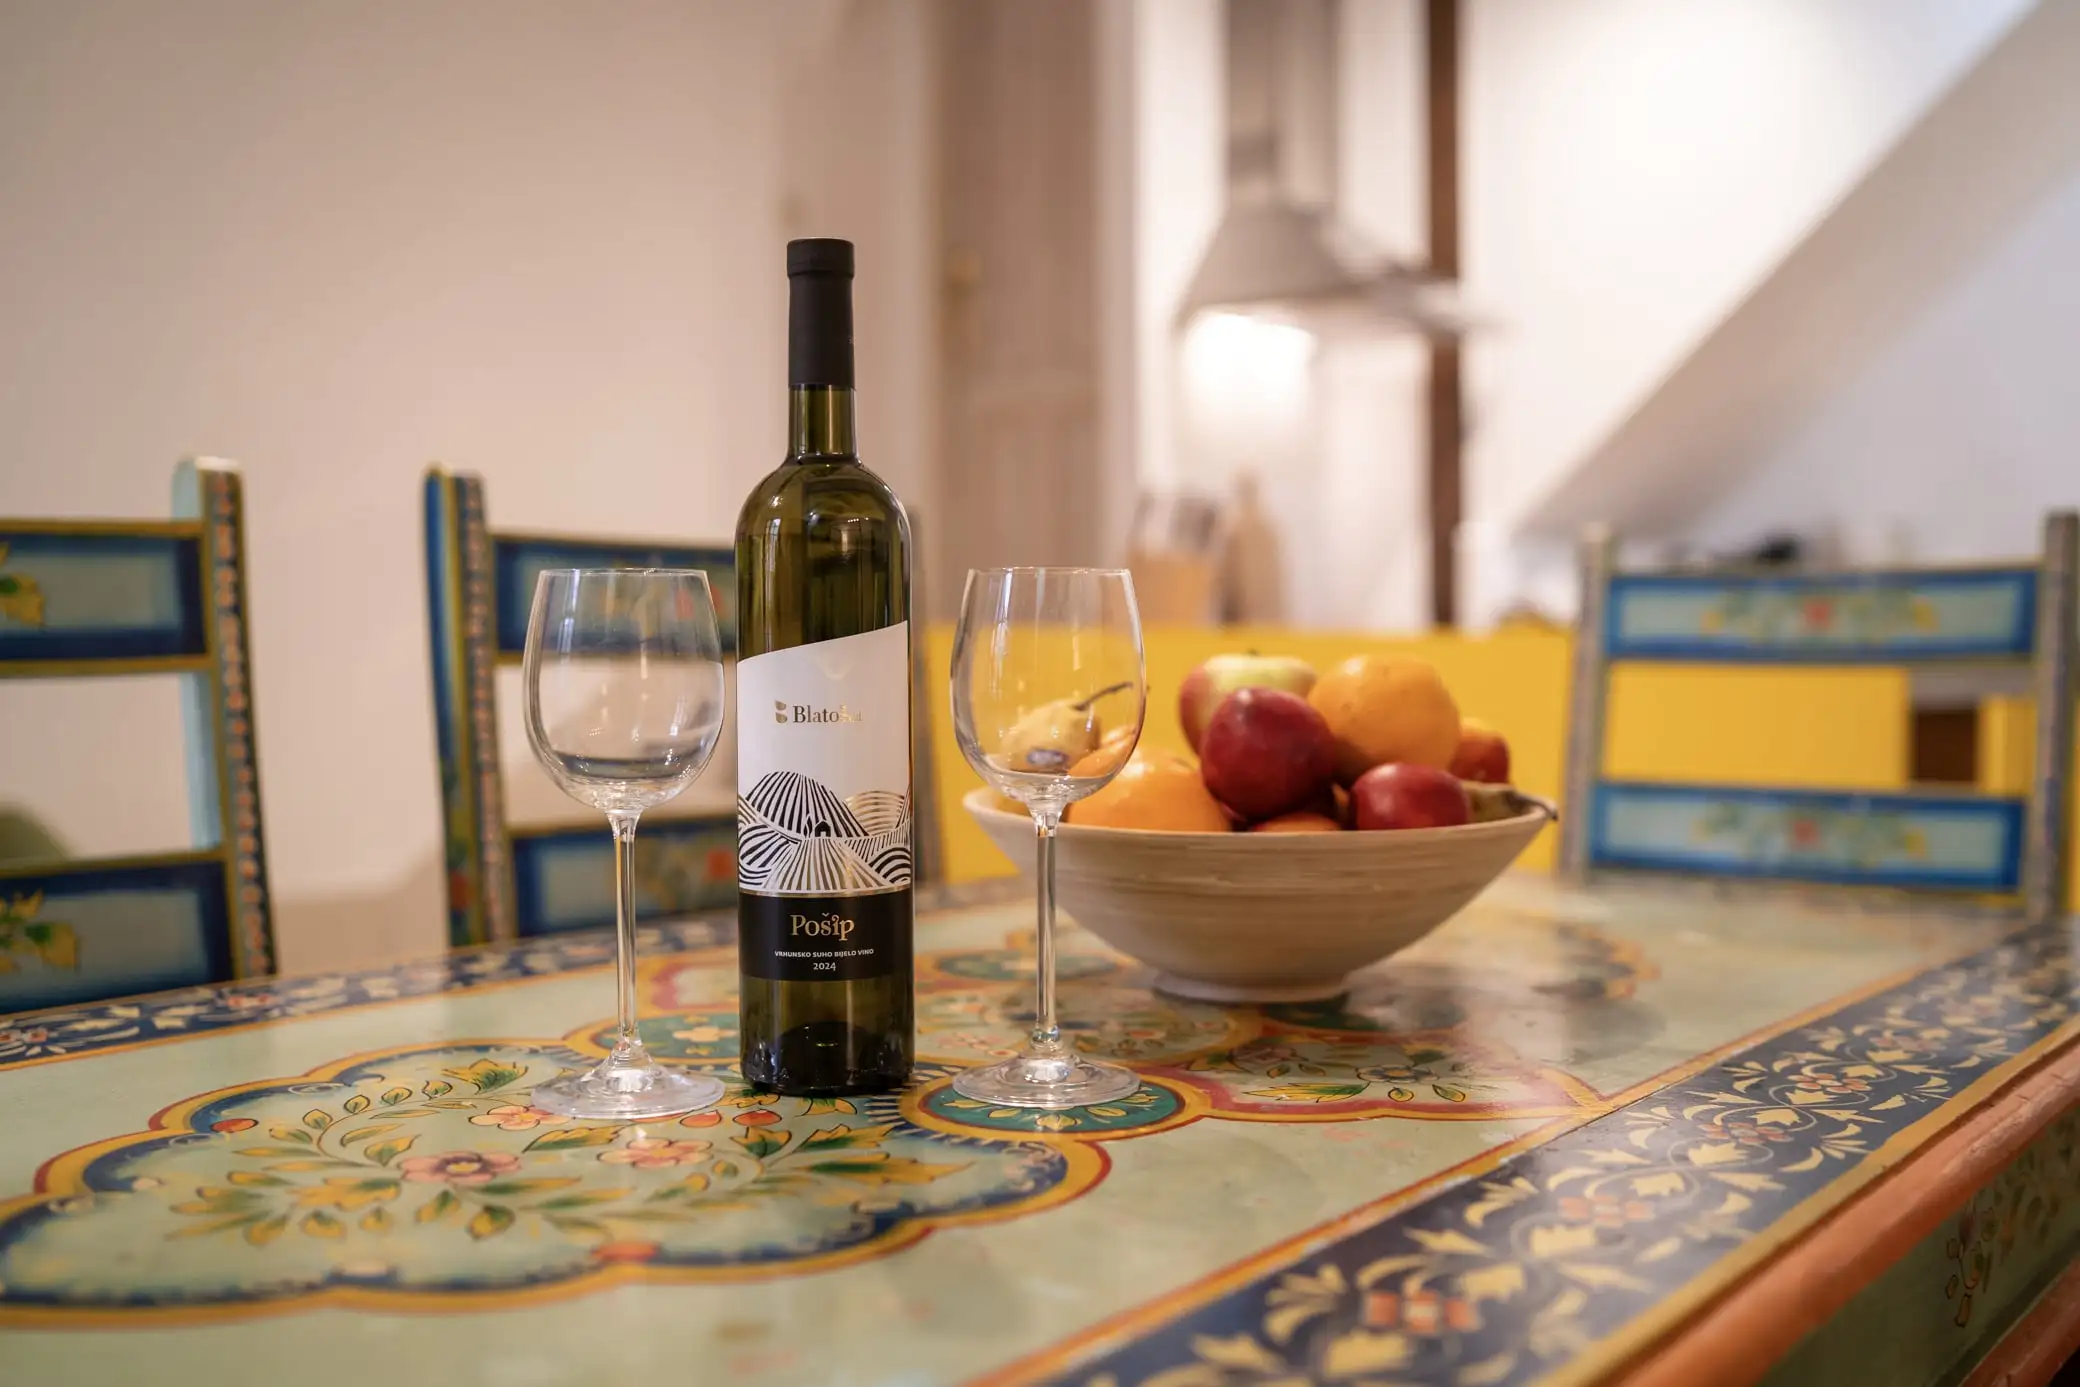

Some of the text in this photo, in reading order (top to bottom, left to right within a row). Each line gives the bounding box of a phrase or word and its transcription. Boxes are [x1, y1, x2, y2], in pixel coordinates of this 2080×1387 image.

[789, 912, 855, 941] Pošip
[774, 950, 811, 958] VRHUNSKO
[834, 950, 857, 958] BIJELO
[813, 962, 837, 971] 2024
